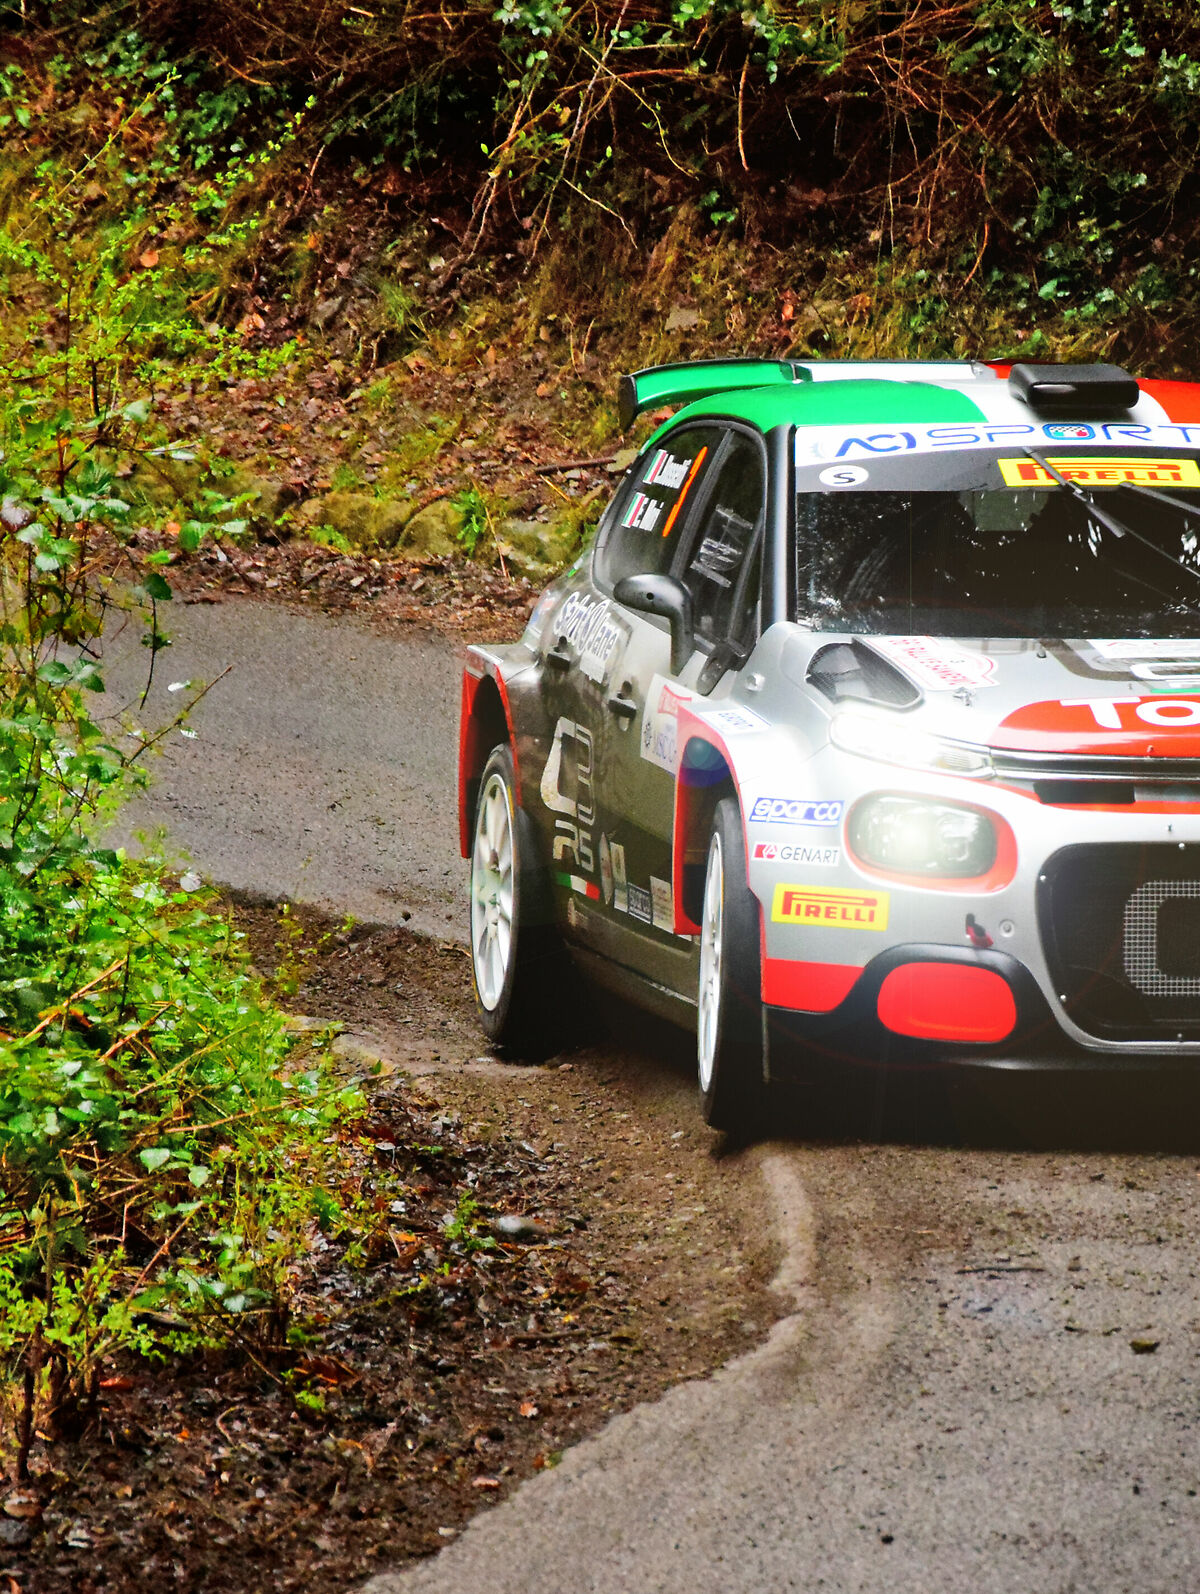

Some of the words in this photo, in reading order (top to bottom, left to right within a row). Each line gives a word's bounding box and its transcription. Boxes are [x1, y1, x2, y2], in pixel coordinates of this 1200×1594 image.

[1016, 462, 1183, 482] PIRELLI
[754, 798, 842, 823] sparco
[780, 846, 838, 864] GENART
[781, 890, 878, 923] PIRELLI
